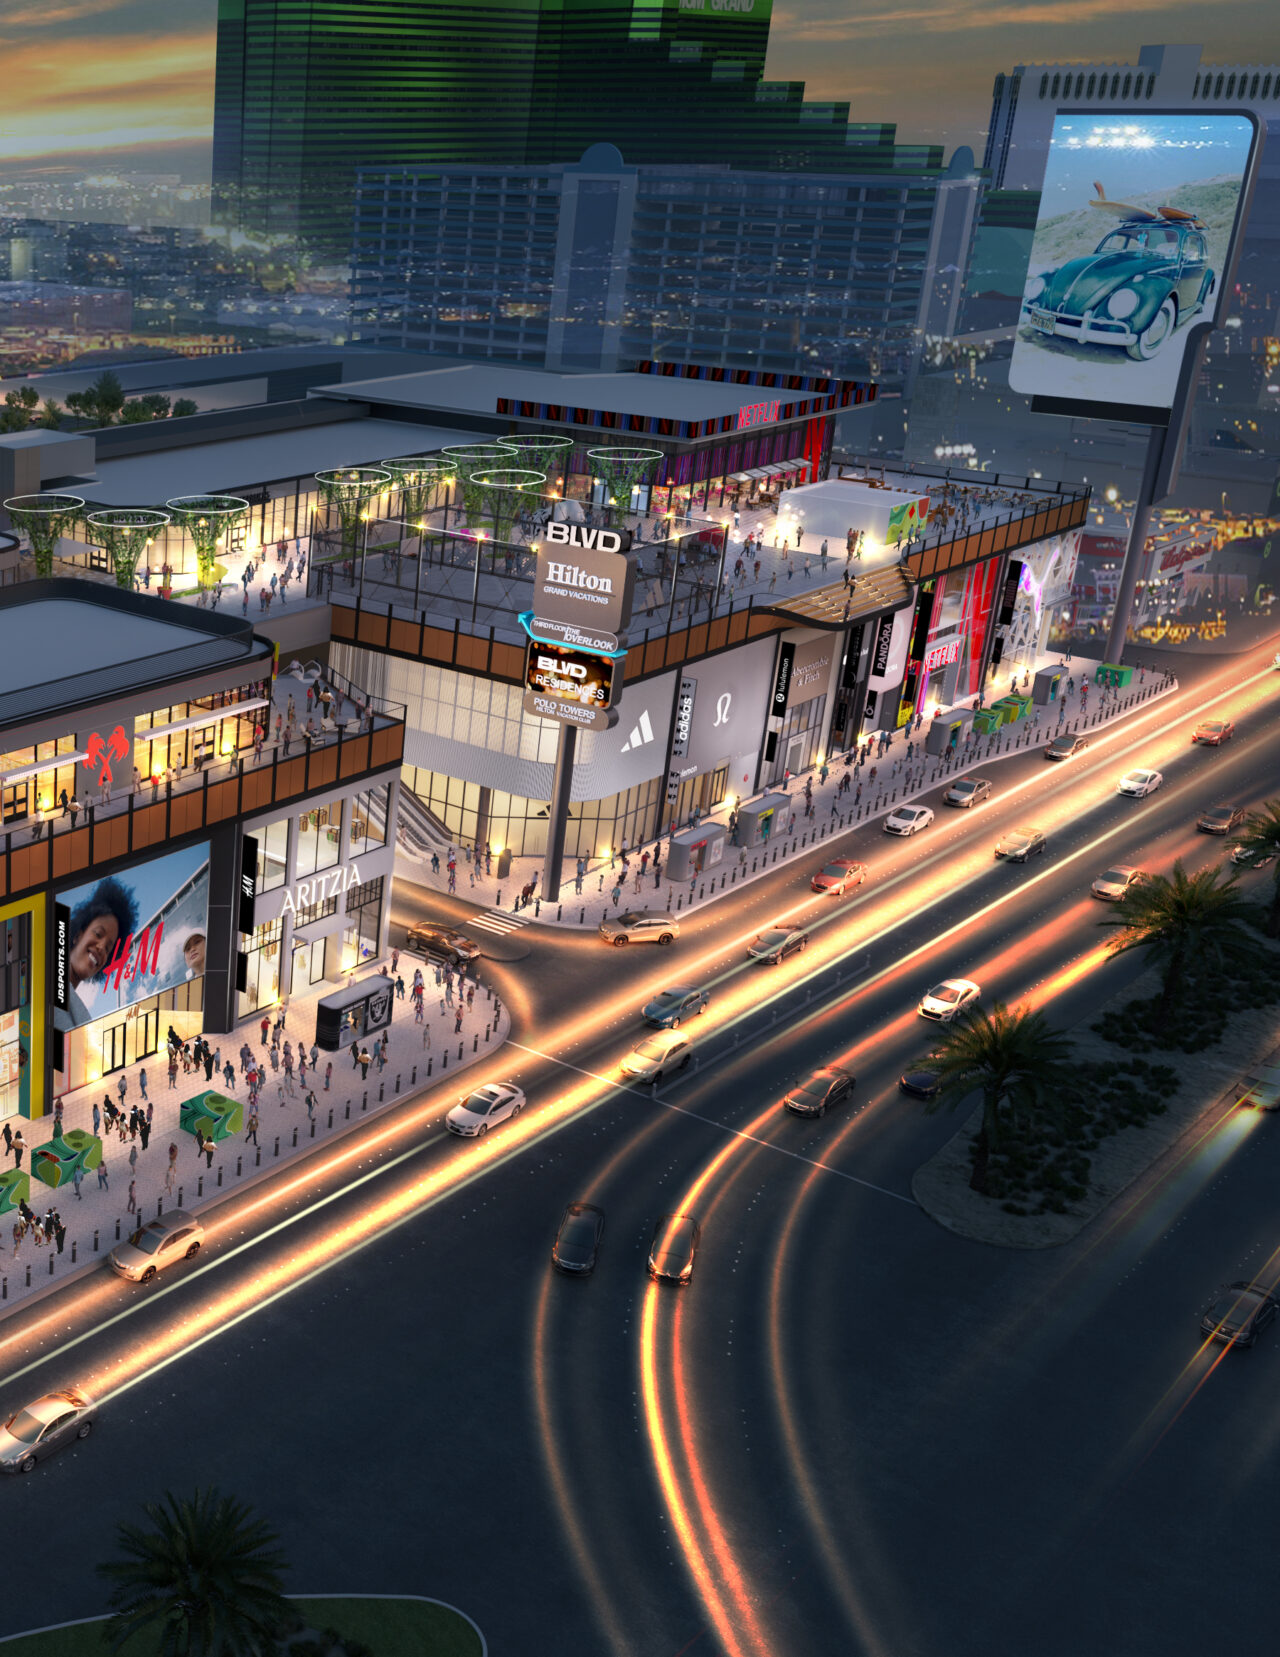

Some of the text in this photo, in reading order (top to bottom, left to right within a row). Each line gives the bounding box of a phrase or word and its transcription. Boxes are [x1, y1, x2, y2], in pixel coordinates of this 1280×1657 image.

[737, 400, 781, 429] NETFLIX
[546, 521, 622, 553] BLVD
[546, 561, 612, 593] Hilton
[543, 585, 609, 605] GRAND VACATIONS
[533, 620, 549, 629] THIRD
[566, 633, 614, 651] OVERLOOK
[924, 640, 961, 673] NETFLIX
[537, 656, 587, 678] BLVD
[778, 658, 789, 693] lululemon
[535, 674, 604, 699] RESIDENCES
[533, 697, 596, 719] POLO TOWERS
[679, 697, 692, 741] adidas
[280, 863, 362, 917] ARITZIA
[57, 920, 66, 1003] JDSPORTS.COM
[102, 921, 165, 994] H&M
